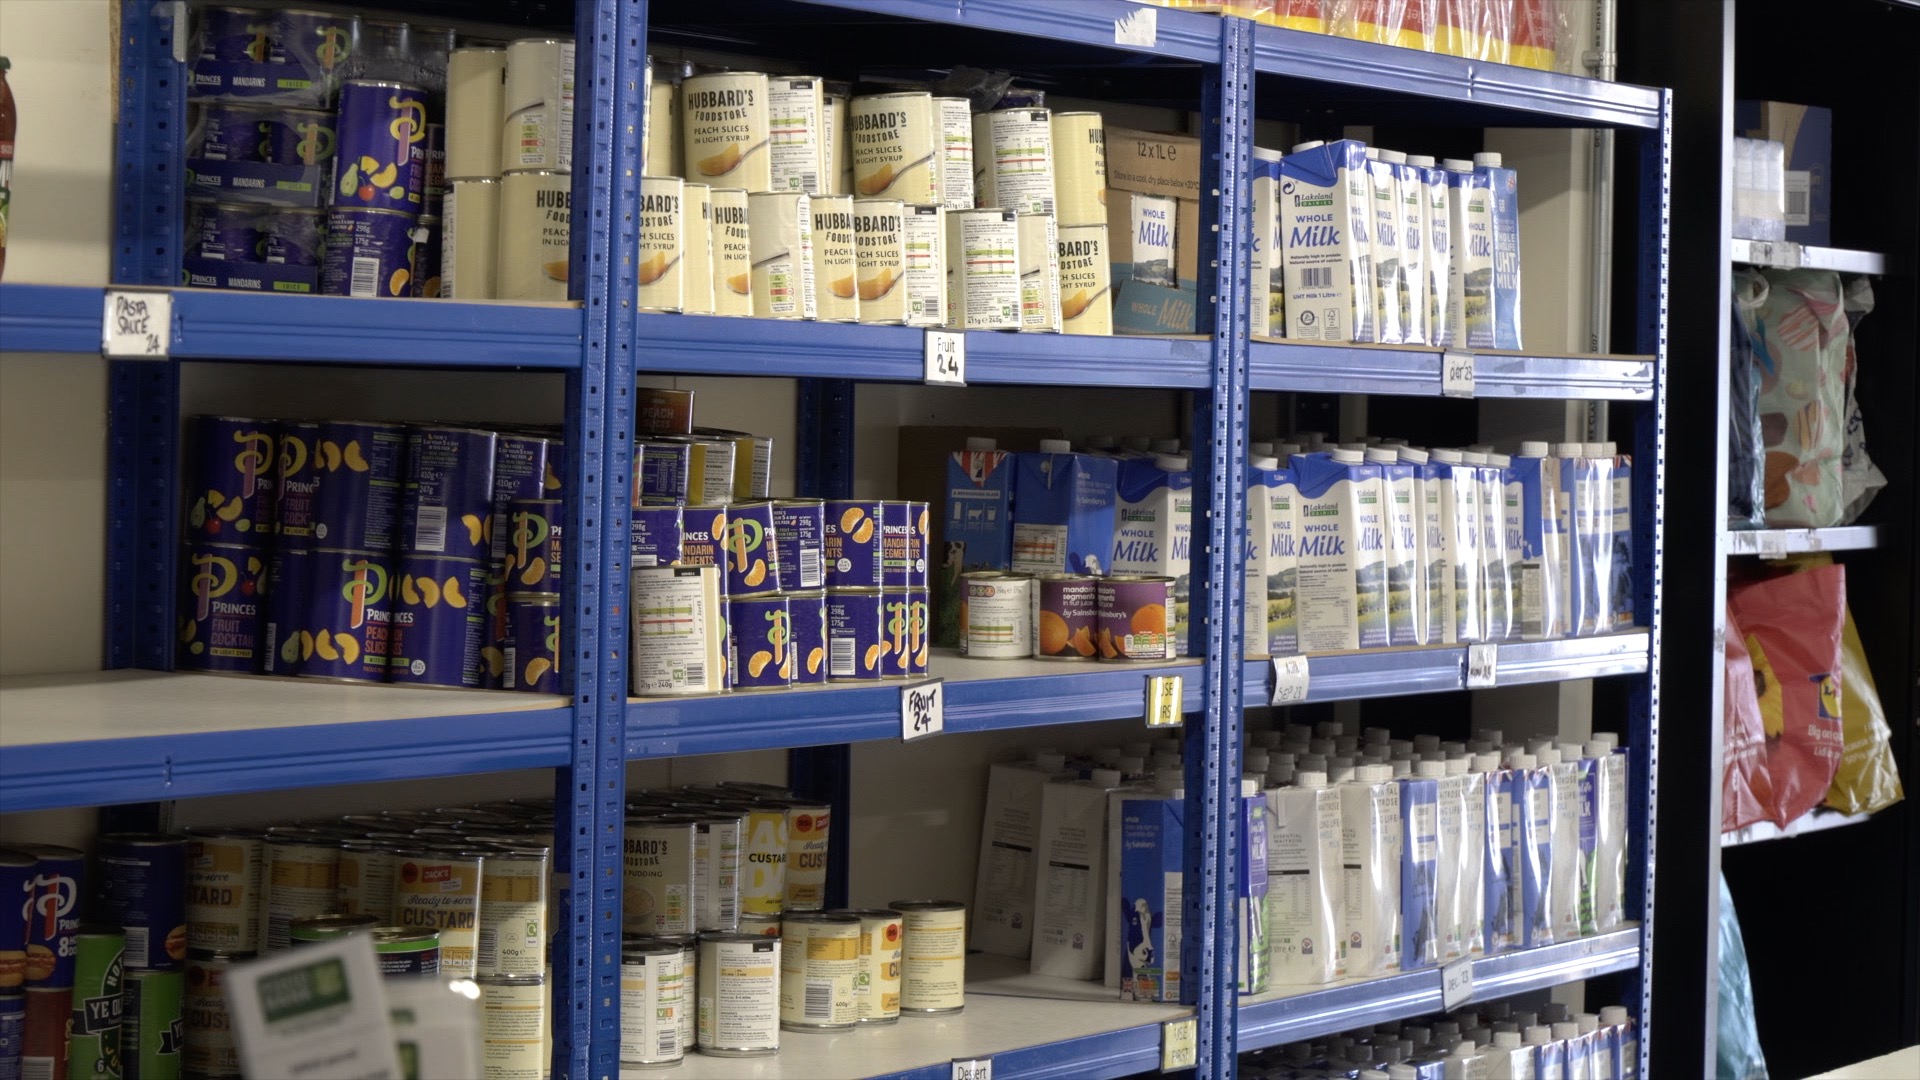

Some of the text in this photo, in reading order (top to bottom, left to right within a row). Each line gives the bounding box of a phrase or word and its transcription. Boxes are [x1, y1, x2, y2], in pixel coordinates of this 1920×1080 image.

[196, 75, 265, 87] PRINCES MANDARINS
[688, 89, 754, 109] HUBBARD'S
[695, 108, 747, 122] FOODSTORE
[694, 125, 749, 135] PEACH SLICES
[694, 135, 750, 145] IN LIGHT SYRUP
[855, 129, 899, 144] FOODSTORE
[875, 145, 902, 154] SLICES
[880, 155, 903, 163] SYRUP
[233, 177, 264, 188] MANDARINS
[1301, 191, 1334, 202] Lakeland
[1142, 208, 1165, 219] WHOLE
[1295, 213, 1334, 223] WHOLE
[649, 232, 675, 241] SLICES
[1139, 220, 1169, 248] Milk
[1290, 225, 1341, 248] Milk
[1376, 223, 1395, 246] Milk
[653, 242, 675, 251] SYRUP
[724, 243, 746, 251] PEACH
[875, 250, 899, 258] SLICES
[1497, 253, 1516, 272] UHT
[192, 275, 261, 289] PRINCES MANDARINS
[1071, 272, 1095, 280] SLICES
[1496, 274, 1517, 289] MILK
[1306, 292, 1317, 300] Milk
[1131, 302, 1156, 316] WHOLE
[1157, 297, 1193, 331] Milk
[117, 315, 150, 335] SAUCE
[937, 336, 955, 354] Fruit
[936, 354, 959, 377] 24
[1127, 508, 1155, 516] Lakeland
[1310, 503, 1338, 511] Lakeland
[1273, 521, 1290, 529] WHOLE
[1304, 524, 1339, 532] WHOLE
[1121, 530, 1154, 538] WHOLE
[1113, 540, 1158, 563] Milk
[1271, 534, 1295, 558] Milk
[1299, 535, 1345, 558] Milk
[1063, 586, 1096, 594] mandarin
[1063, 593, 1096, 601] segments
[212, 601, 256, 615] PRINCES
[831, 607, 845, 616] 298g
[1063, 610, 1072, 619] by
[212, 619, 240, 632] FRUIT
[831, 619, 845, 628] 175g
[211, 632, 254, 646] COCKTAIL
[658, 681, 673, 689] 240g
[908, 688, 937, 713] FRUIT
[913, 712, 931, 732] 24
[1808, 724, 1832, 740] Big on
[1384, 814, 1398, 824] LIFE
[631, 870, 663, 878] PUDDING
[408, 895, 440, 907] Ready
[442, 896, 451, 905] to
[403, 908, 474, 929] CUSTARD
[58, 936, 70, 958] 8
[502, 948, 519, 957] 400g
[90, 1000, 109, 1020] YE
[97, 1059, 104, 1073] 6
[958, 1066, 986, 1080] Desert
